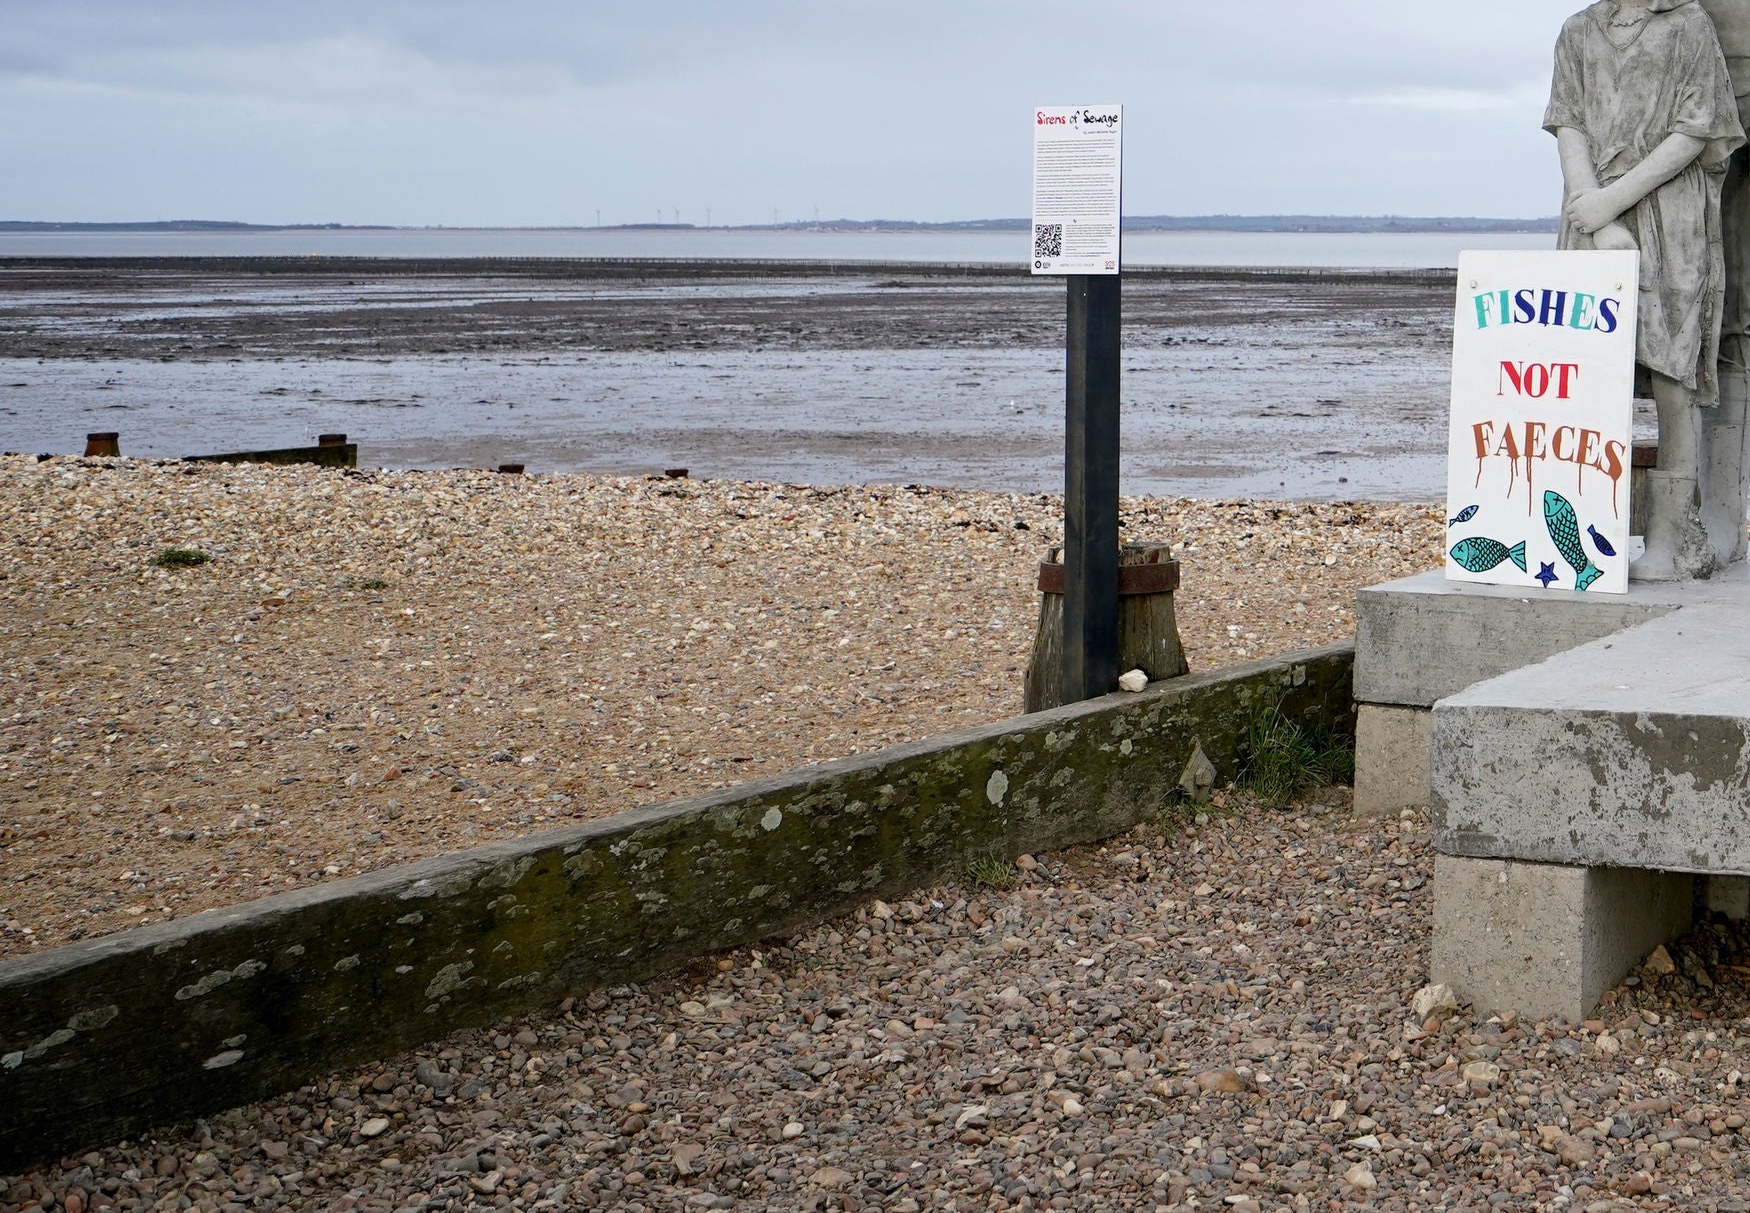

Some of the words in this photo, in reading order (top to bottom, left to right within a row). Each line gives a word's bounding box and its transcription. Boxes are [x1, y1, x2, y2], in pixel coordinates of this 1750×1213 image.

[1036, 111, 1066, 125] Sirens
[1070, 110, 1080, 125] of
[1083, 110, 1118, 127] Sewage
[1472, 289, 1621, 333] FISHES
[1497, 361, 1578, 399] NOT
[1471, 421, 1626, 481] FAECES
